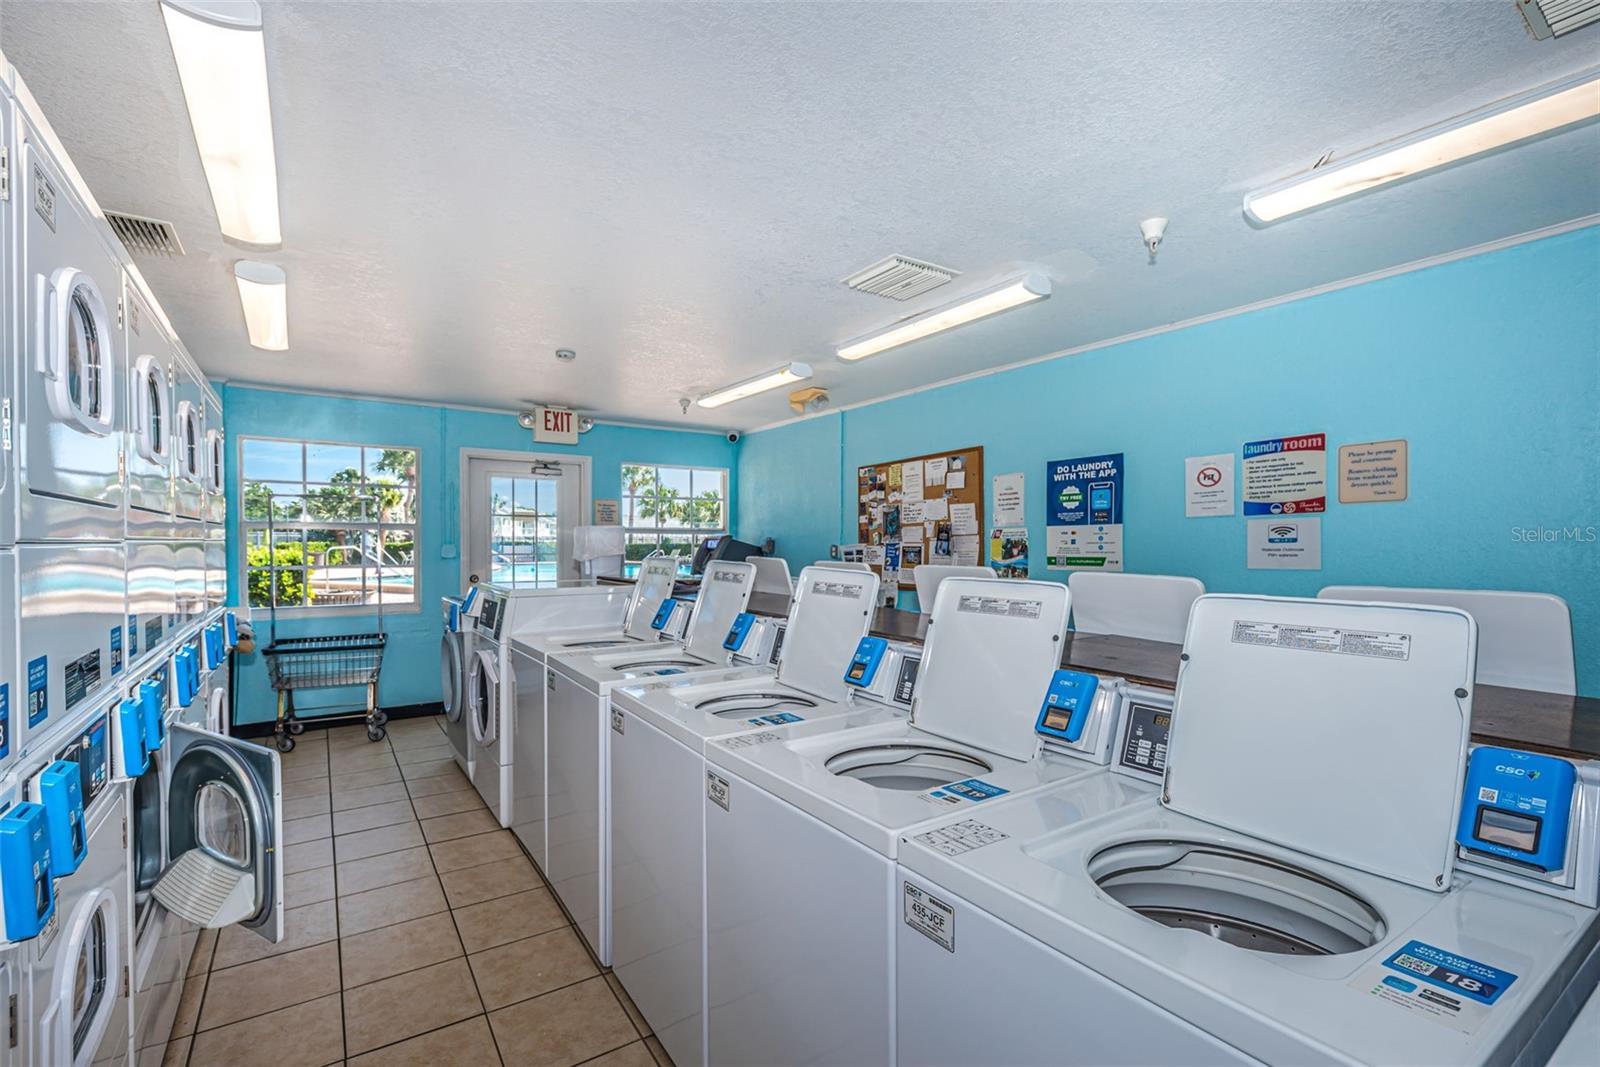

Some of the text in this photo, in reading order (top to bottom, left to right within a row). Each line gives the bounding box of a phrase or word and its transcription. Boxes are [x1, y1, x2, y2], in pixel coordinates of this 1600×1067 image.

[544, 410, 572, 432] EXIT
[1054, 468, 1116, 482] WITH THE APP
[1071, 461, 1114, 472] LAUNDRY
[1495, 765, 1525, 776] CSC
[912, 903, 944, 927] 435-JCF
[1445, 972, 1482, 992] 18
